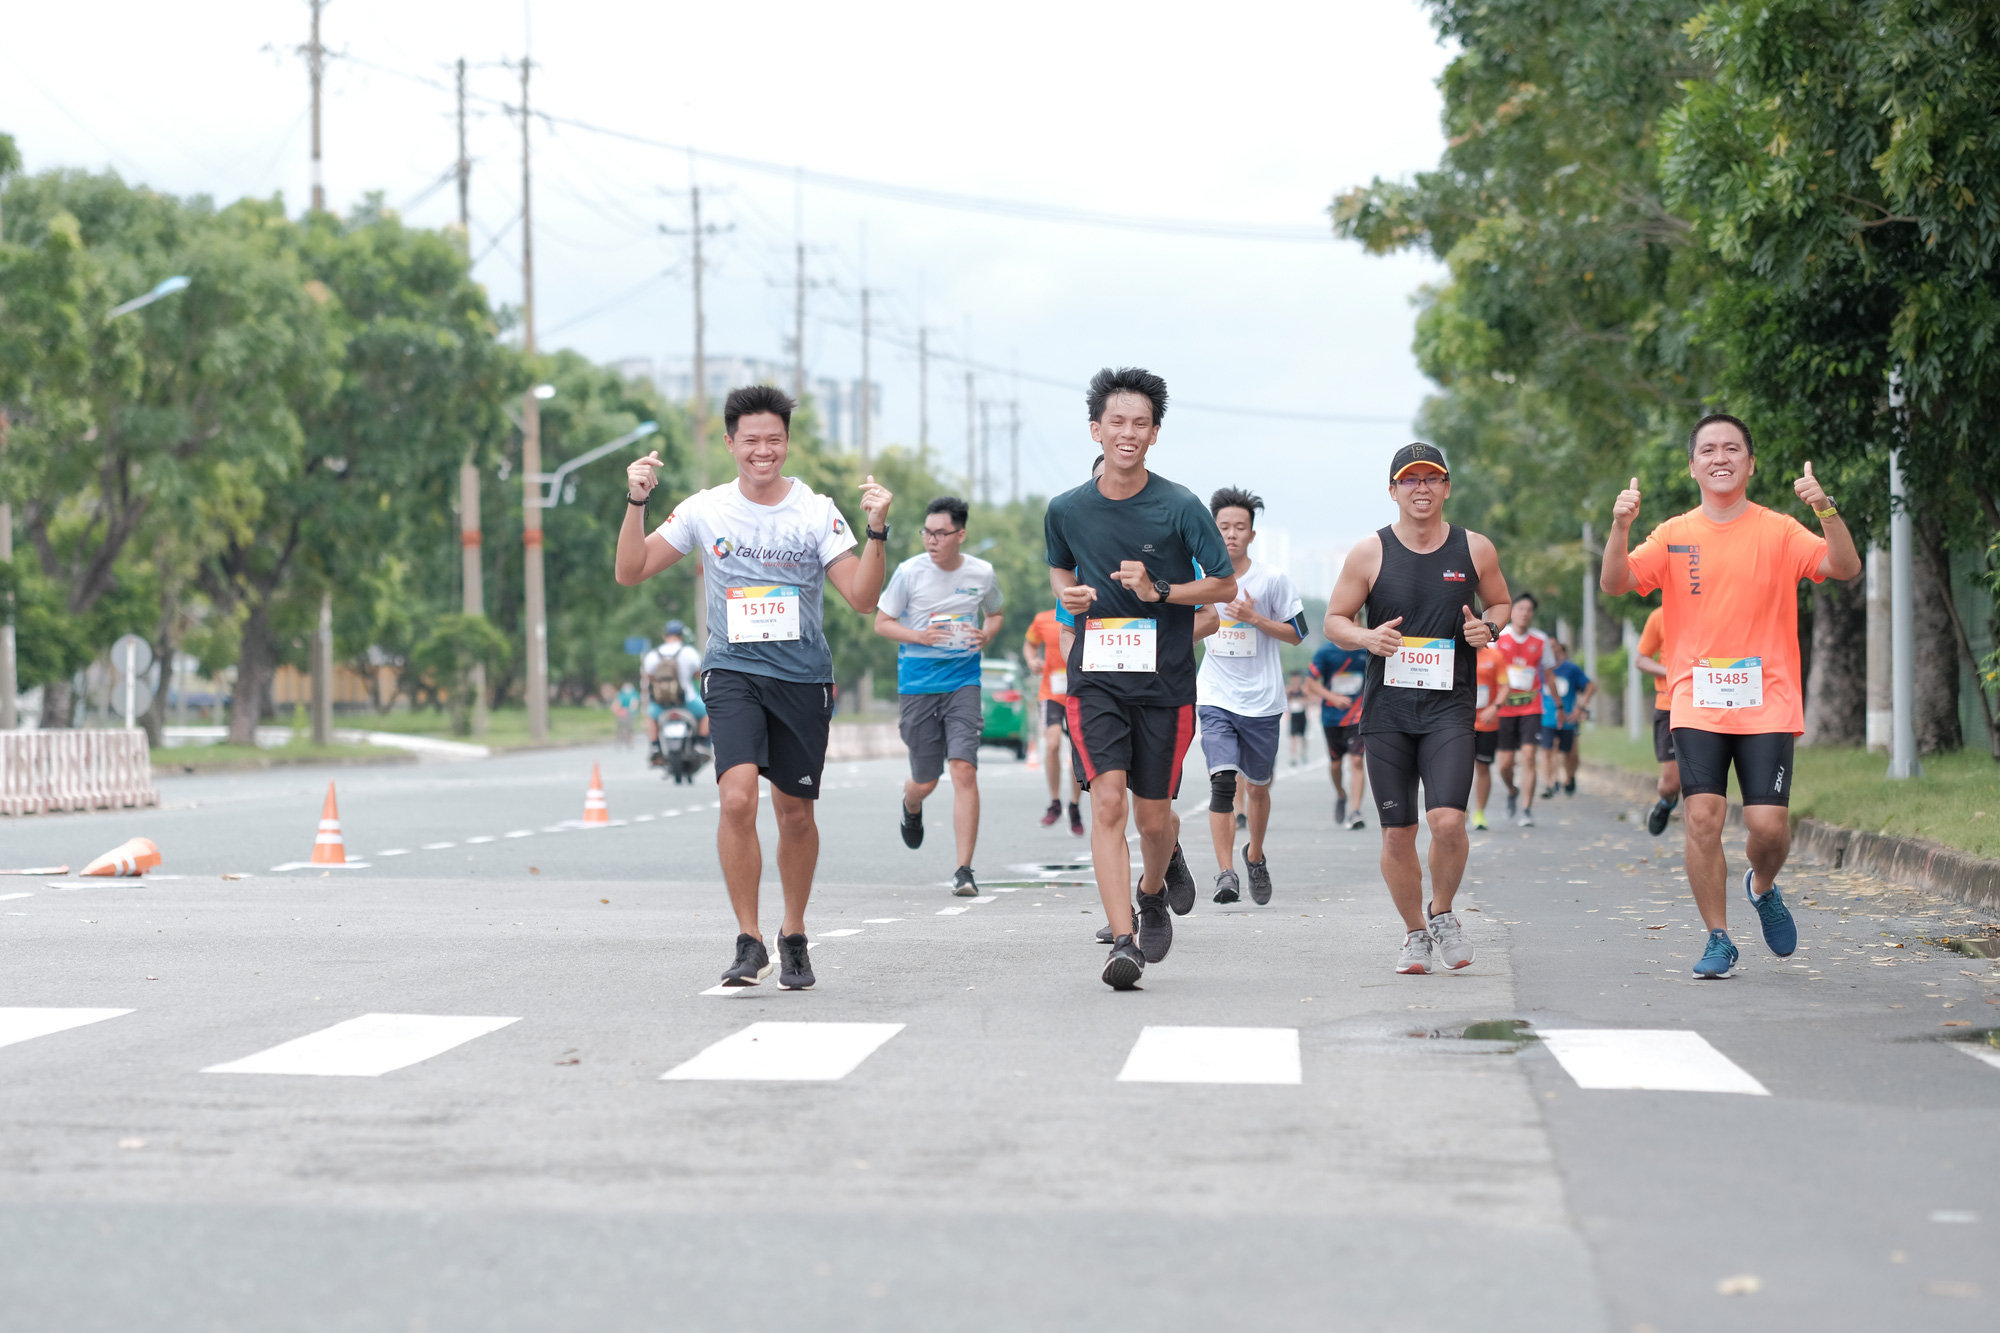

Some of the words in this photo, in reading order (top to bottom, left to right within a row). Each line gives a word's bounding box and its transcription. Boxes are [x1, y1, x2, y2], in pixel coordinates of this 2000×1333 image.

[736, 545, 807, 562] tailwind
[742, 602, 785, 615] 15176
[1099, 634, 1141, 646] 15115
[1218, 630, 1246, 640] 15798
[1400, 651, 1440, 665] 15001
[1707, 672, 1748, 685] 15485
[1774, 765, 1785, 793] 2XU
